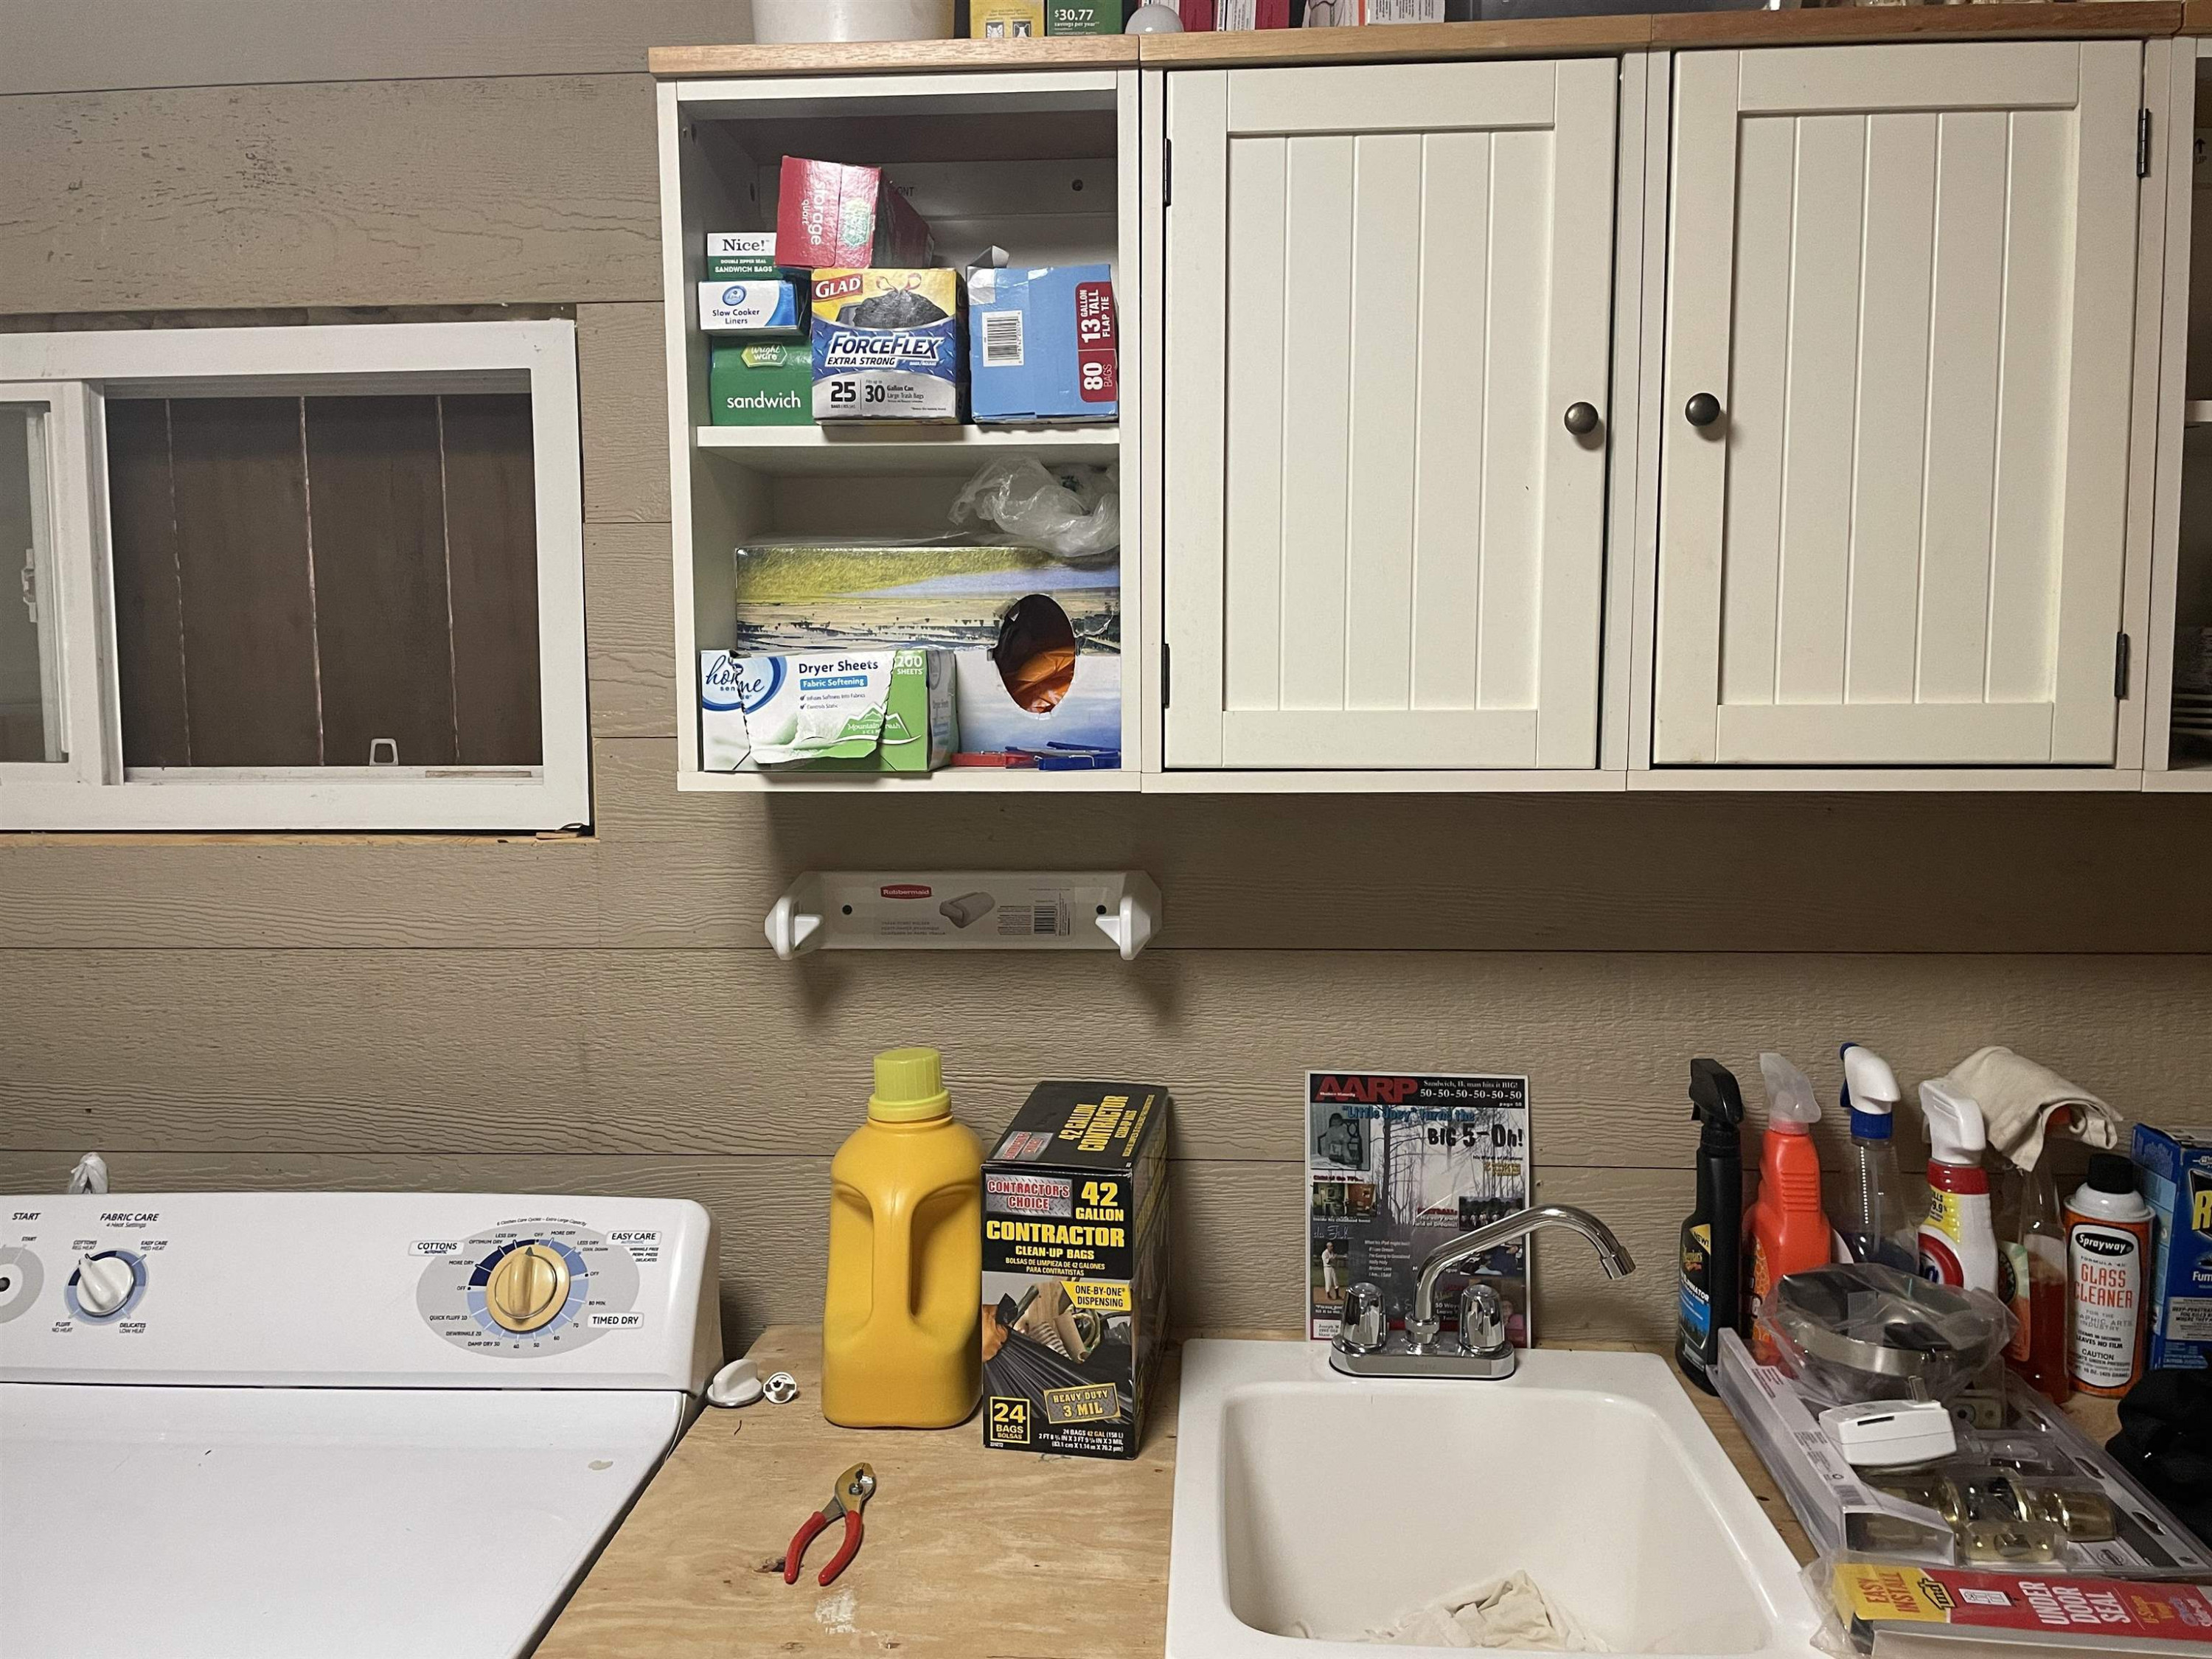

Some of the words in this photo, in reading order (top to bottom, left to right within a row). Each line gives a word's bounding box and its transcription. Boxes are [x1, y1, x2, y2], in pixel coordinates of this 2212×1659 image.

[1054, 9, 1093, 21] $30.77
[801, 199, 810, 226] quart
[808, 181, 827, 246] storage
[723, 239, 765, 251] Nice!
[815, 277, 861, 298] GLAD
[1079, 289, 1088, 317] GALLON
[1088, 289, 1099, 316] TALL
[1101, 296, 1109, 310] TIE
[1081, 319, 1101, 344] 13
[1102, 313, 1110, 337] FLAP
[859, 358, 895, 366] STRONG
[1083, 362, 1103, 390] 80
[1103, 364, 1113, 387] BAGS
[727, 391, 801, 408] sandwich
[830, 382, 856, 403] 25
[865, 385, 885, 403] 30
[799, 663, 834, 675] Dryer
[838, 660, 878, 671] Sheets
[895, 655, 922, 667] 200
[827, 678, 864, 686] Softening
[1315, 1077, 1418, 1103] AARP
[1064, 1104, 1098, 1130] GALLON
[1077, 1095, 1130, 1152] CONTRACTOR
[1058, 1129, 1084, 1141] 42
[1427, 1127, 1457, 1147] BIG
[1463, 1122, 1523, 1147] 5-Oh!
[988, 1181, 1070, 1197] CONTRACTOR'S
[1081, 1181, 1118, 1207] 42
[1008, 1196, 1049, 1210] CHOICE
[13, 1212, 41, 1220] START
[1076, 1207, 1124, 1222] GALLON
[987, 1220, 1124, 1248] CONTRACTOR
[2079, 1234, 2126, 1253] Sprayway
[1015, 1245, 1063, 1258] CLEAN-UP
[1067, 1249, 1094, 1260] BAGS
[1005, 1257, 1027, 1265] BOLSAS
[1037, 1259, 1062, 1267] LIMPIEZA
[1079, 1262, 1105, 1270] GALONES
[1043, 1267, 1085, 1276] CONTRATISTAS
[2081, 1264, 2126, 1288] GLASS
[1075, 1285, 1122, 1295] ONE-BY-ONE
[2074, 1281, 2132, 1309] CLEANER
[1077, 1297, 1124, 1307] DISPENSING
[592, 1316, 619, 1325] TIMED
[621, 1316, 639, 1325] DRY
[2081, 1349, 2115, 1361] CAUTION
[1053, 1393, 1081, 1403] HEAVY
[1085, 1390, 1108, 1399] DUTY
[993, 1402, 1026, 1424] 24
[1062, 1405, 1072, 1418] 3
[1077, 1402, 1104, 1416] MIL
[996, 1424, 1023, 1433] BAGS
[1857, 1577, 1891, 1604] EASY
[1879, 1572, 1920, 1613] INSTALL
[2018, 1581, 2070, 1625] UNDER
[2051, 1586, 2101, 1624] DOOR
[2084, 1590, 2132, 1624] SEAL
